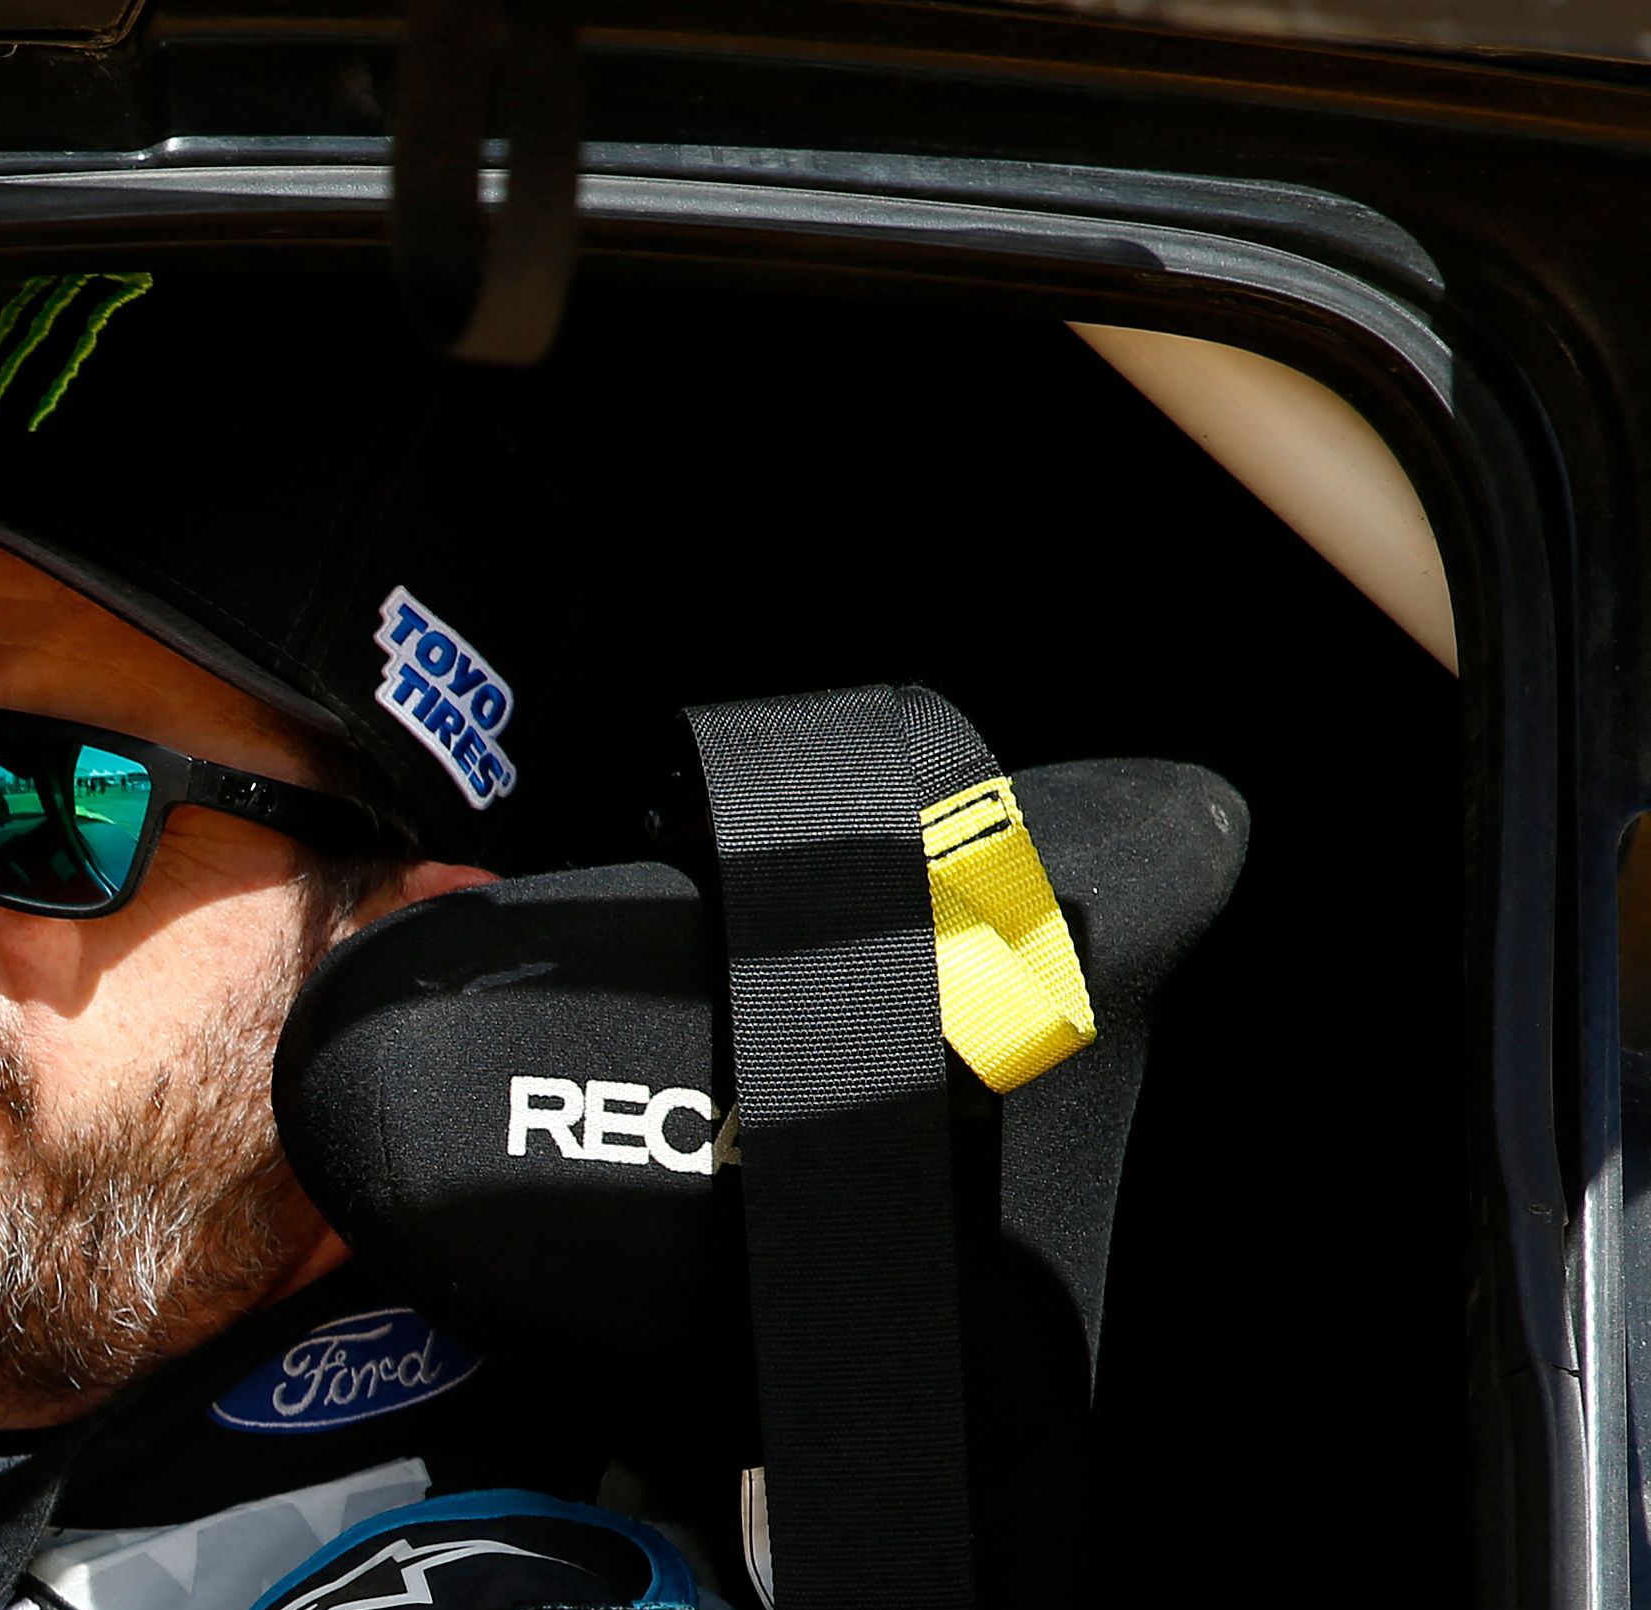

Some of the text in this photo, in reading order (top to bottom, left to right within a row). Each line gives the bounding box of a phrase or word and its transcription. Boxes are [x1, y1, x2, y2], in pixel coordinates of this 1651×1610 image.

[391, 604, 506, 732] TOYO
[392, 663, 504, 798] TIRES
[272, 1323, 445, 1416] Ford
